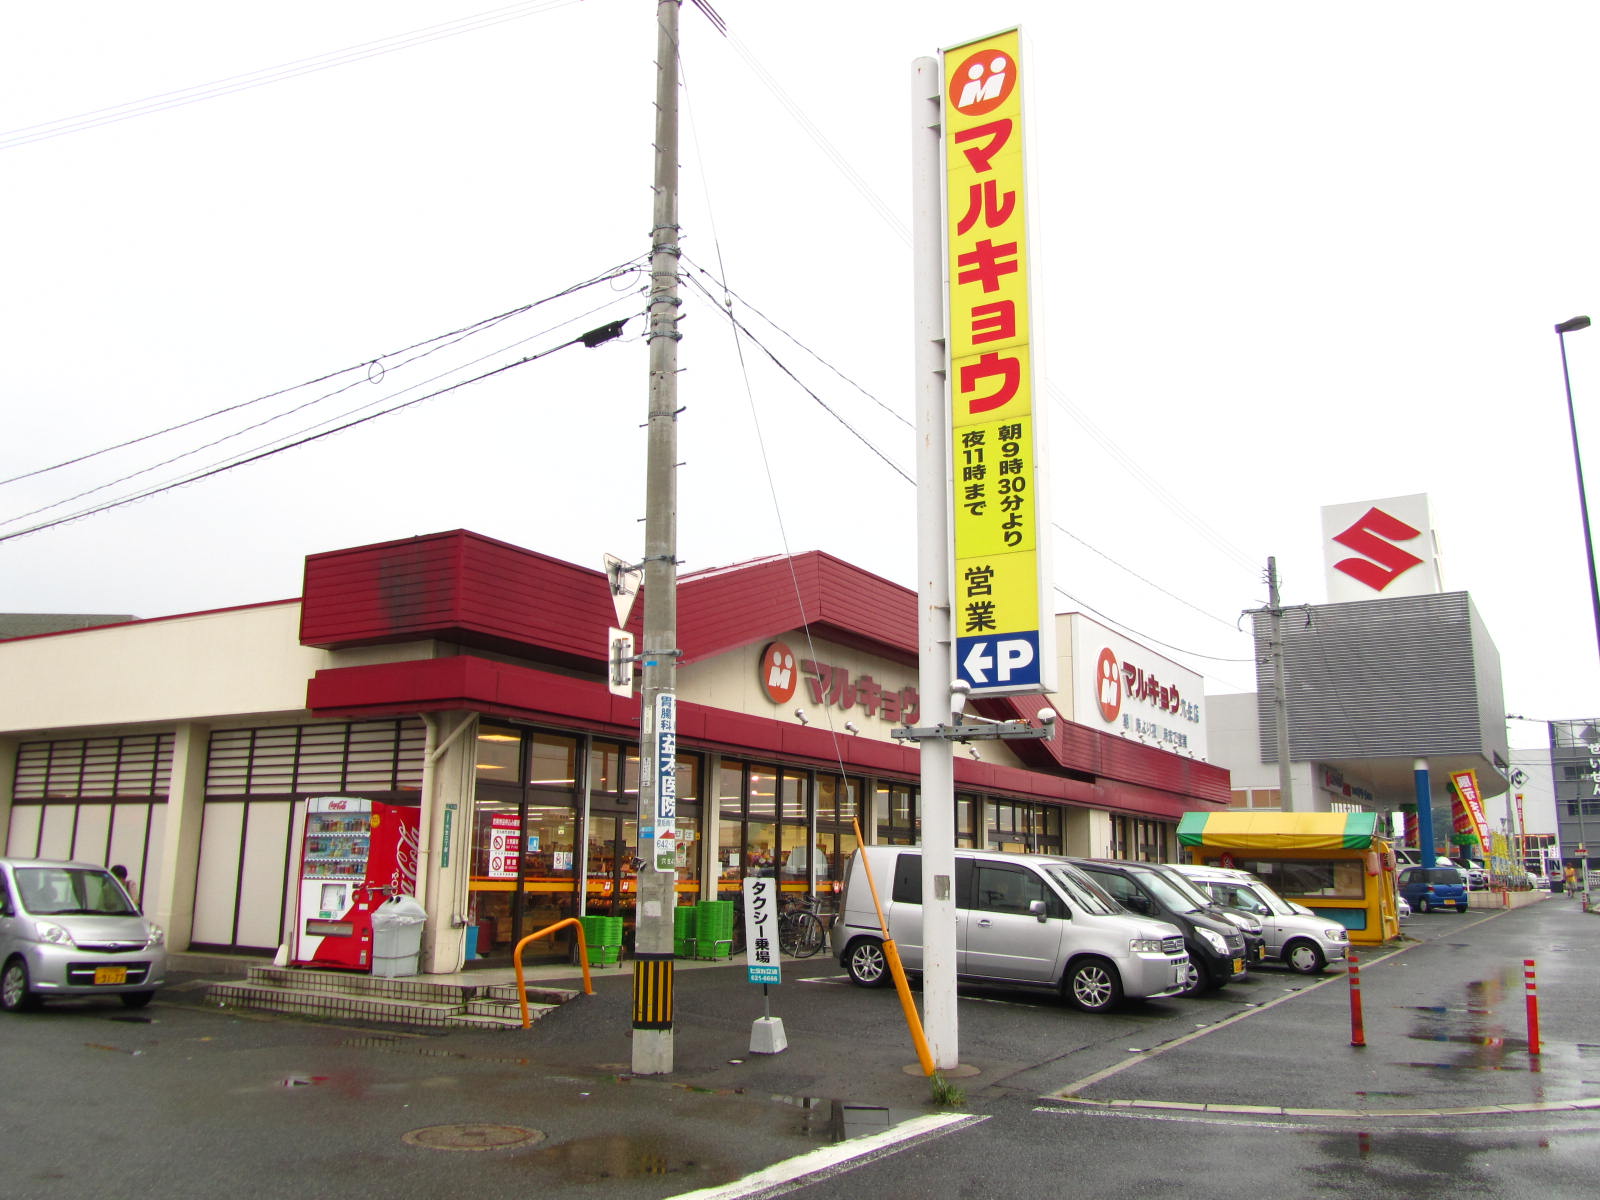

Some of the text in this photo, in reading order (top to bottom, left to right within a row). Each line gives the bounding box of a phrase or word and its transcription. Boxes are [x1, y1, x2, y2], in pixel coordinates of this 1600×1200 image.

[954, 118, 1021, 415] マルキョウ
[962, 431, 987, 516] 夜11時まで
[998, 423, 1025, 547] 朝9時30分より
[964, 565, 996, 632] 営業
[802, 659, 920, 725] マルキョウ
[997, 638, 1034, 682] P
[1122, 661, 1180, 714] マルキョウ
[661, 695, 672, 731] 胃腸科
[752, 881, 770, 963] タクシー乗場
